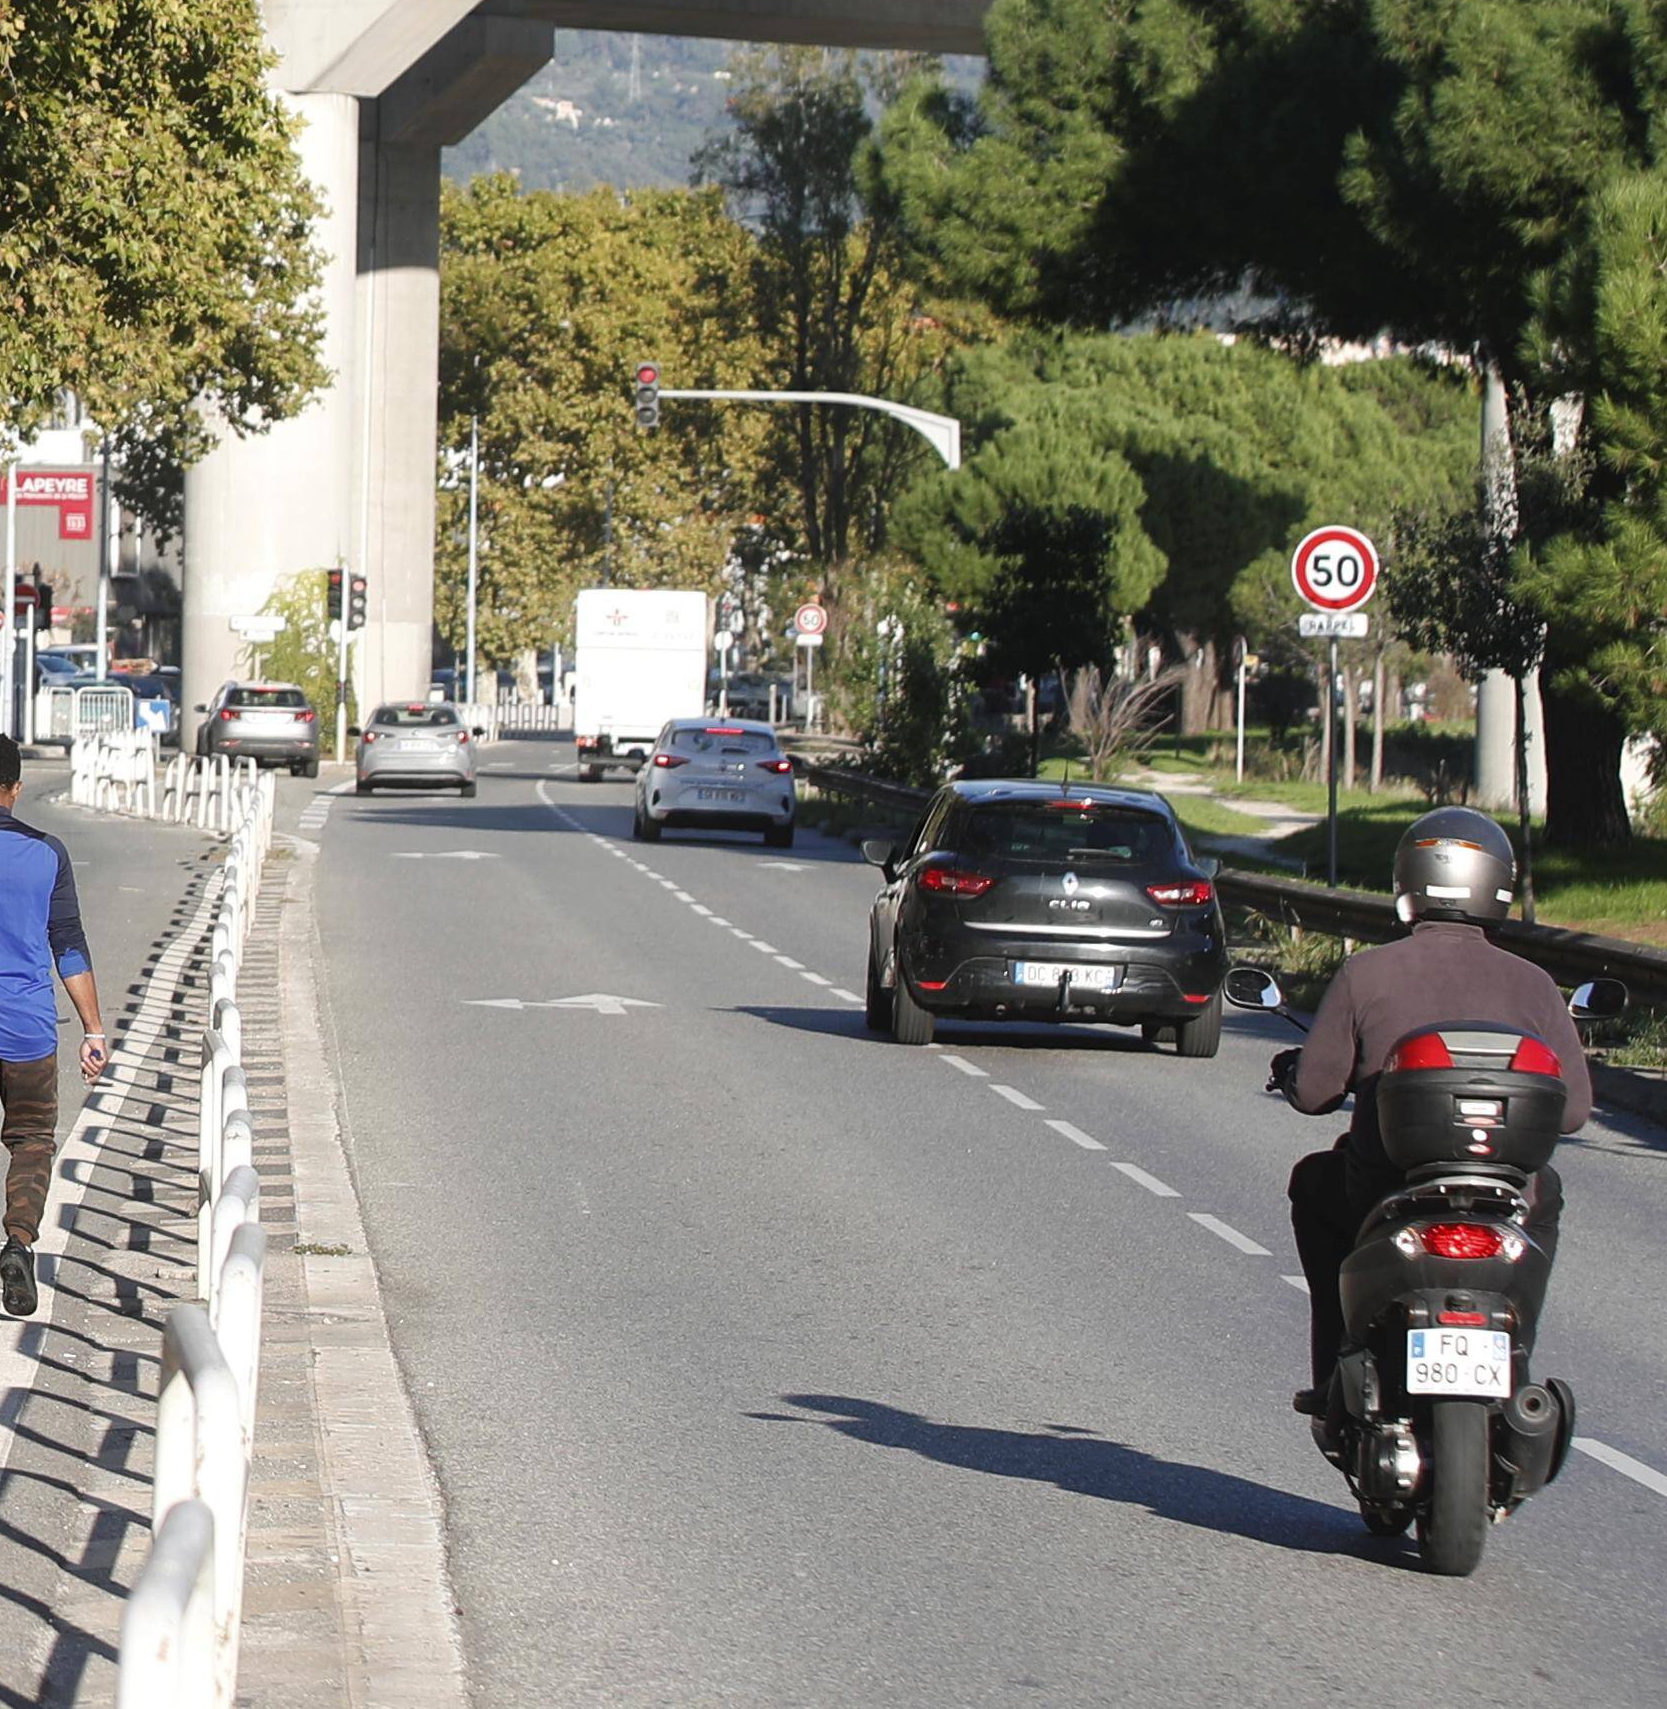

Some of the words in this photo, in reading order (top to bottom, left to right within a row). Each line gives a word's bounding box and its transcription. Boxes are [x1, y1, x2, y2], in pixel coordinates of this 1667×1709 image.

[1313, 555, 1359, 586] 50
[1309, 620, 1356, 631] RAPPEL
[1049, 899, 1091, 910] CLIO
[1052, 966, 1079, 982] 83
